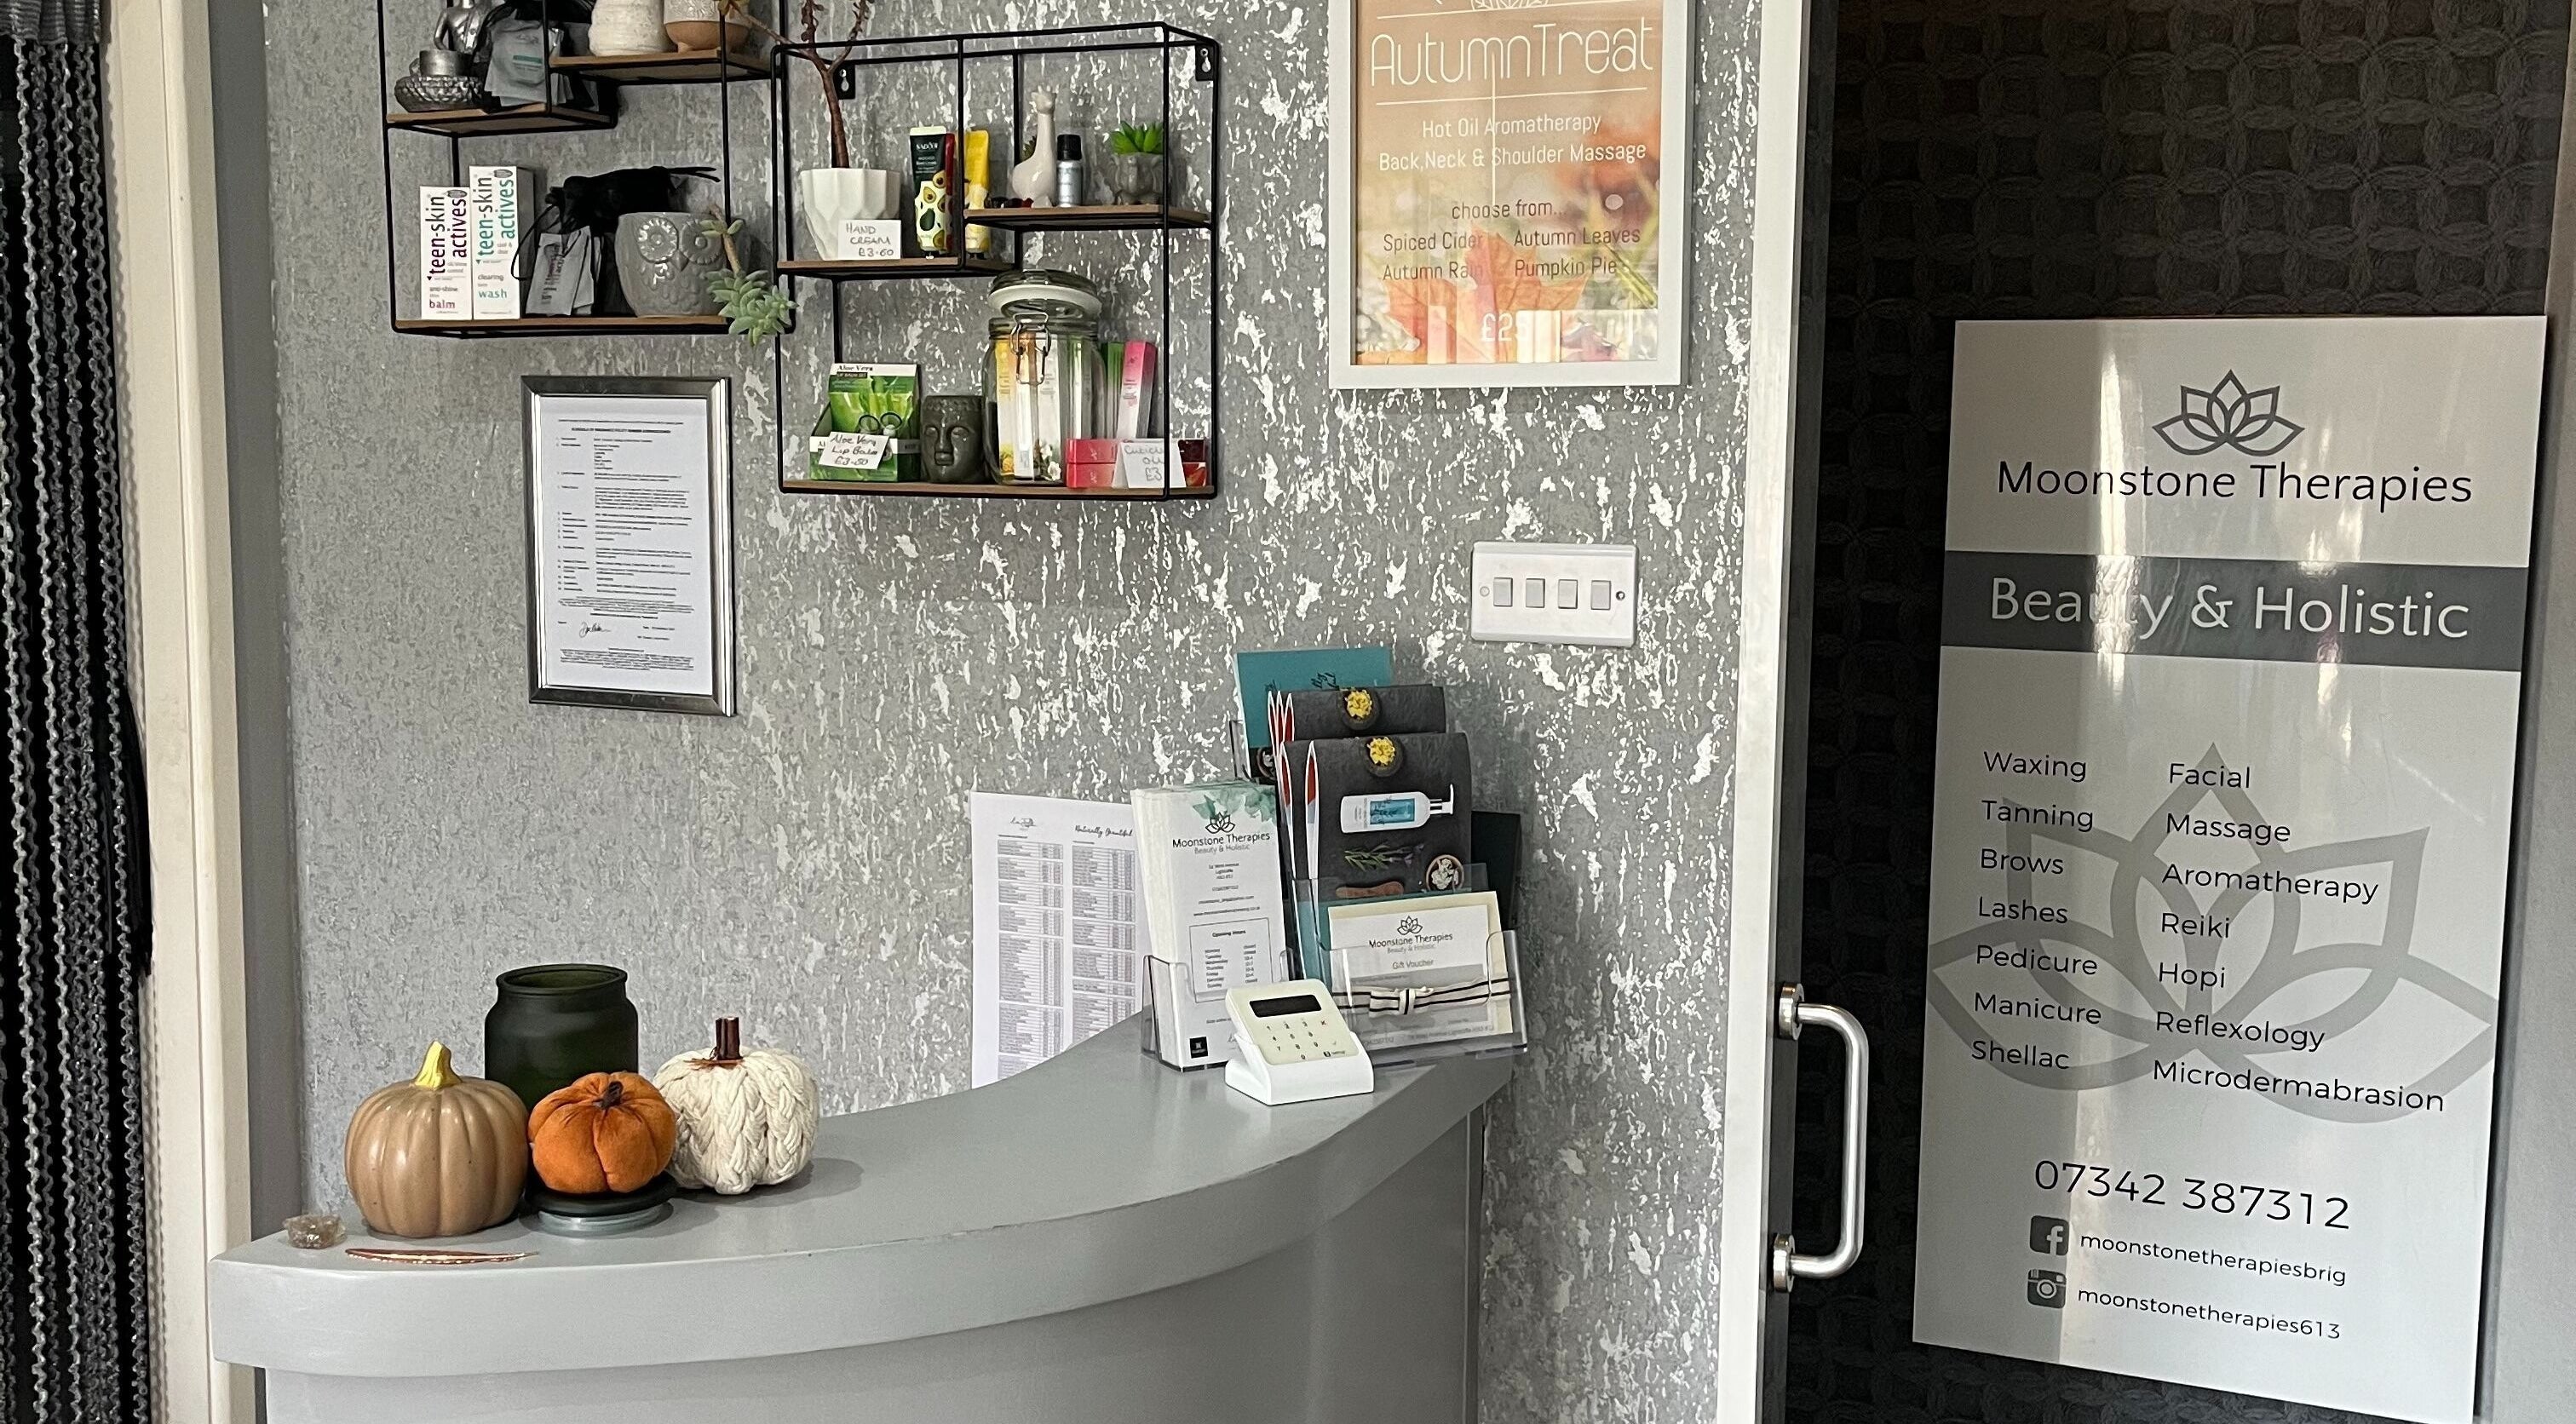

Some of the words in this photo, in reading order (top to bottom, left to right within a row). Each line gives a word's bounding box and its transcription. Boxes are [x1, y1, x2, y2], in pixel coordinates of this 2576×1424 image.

[1422, 120, 1452, 138] Hot
[1458, 118, 1479, 137] Oil
[1485, 112, 1601, 135] Aromatherapy
[1472, 148, 1486, 167] &
[1491, 146, 1564, 166] Shoulder
[1570, 143, 1647, 164] Massage
[473, 176, 495, 256] teen-skin
[495, 179, 515, 239] actives
[1452, 203, 1510, 220] choose
[425, 196, 446, 274] teen-skin
[447, 198, 468, 258] actives
[845, 222, 876, 233] HAND
[1383, 233, 1436, 254] Spiced
[1442, 231, 1483, 249] Cider
[1515, 229, 1576, 247] Autumn
[1583, 227, 1641, 245] Leaves
[1383, 263, 1442, 281] Autumn
[1515, 258, 1584, 280] Pumpkin
[1591, 257, 1618, 275] Pie
[429, 299, 456, 309] balm
[478, 288, 508, 299] wash
[1998, 460, 2236, 498] Moonstone
[2250, 462, 2473, 513] Therapies
[2190, 583, 2234, 629] &
[2255, 583, 2470, 640] Holistic
[1983, 750, 2088, 784] Waxing
[2169, 762, 2251, 789] Facial
[1981, 800, 2094, 833] Tanning
[2165, 812, 2291, 846] Massage
[1172, 836, 1224, 847] Moonstone
[1227, 832, 1271, 844] Therapies
[1981, 848, 2065, 876] Brows
[2161, 863, 2379, 905] Aromatherapy
[1978, 896, 2068, 924] Lashes
[1369, 938, 1413, 948] Moonstone
[1415, 933, 1453, 944] Therapies
[2161, 912, 2231, 939] Reiki
[1406, 959, 1434, 968] Voucher
[1975, 944, 2098, 976] Pedicure
[2158, 962, 2227, 990] Hopi
[1974, 991, 2102, 1025] Manicure
[2156, 1011, 2326, 1052] Reflexology
[1970, 1039, 2071, 1071] Shellac
[2153, 1059, 2445, 1113] Microdermabrasion
[2034, 1159, 2166, 1206] 07342
[2182, 1177, 2350, 1230] 387312
[2079, 1232, 2347, 1288] moonstonetherapiesbrig
[2077, 1287, 2341, 1341] moonstonetherapies613
